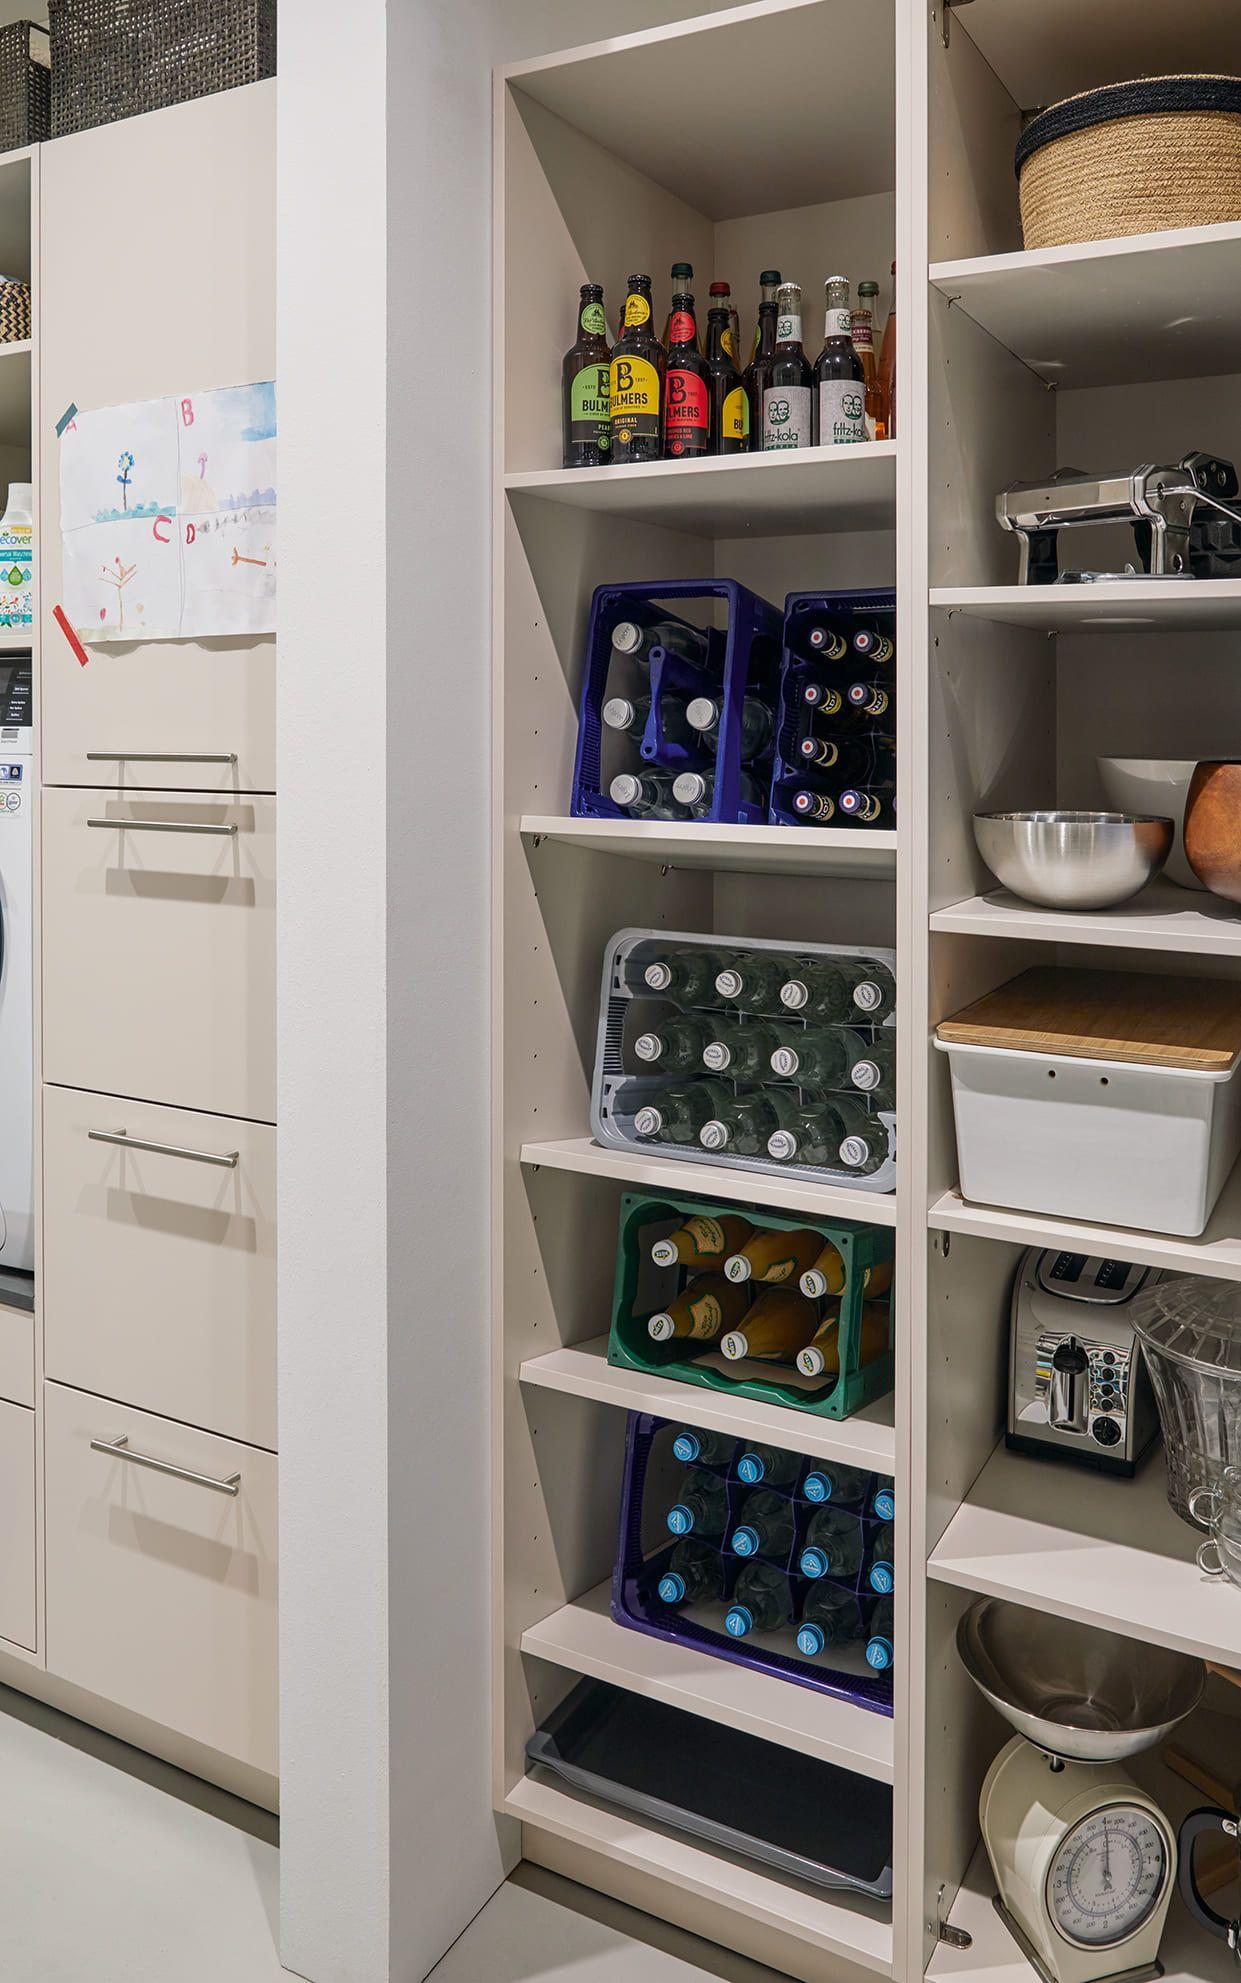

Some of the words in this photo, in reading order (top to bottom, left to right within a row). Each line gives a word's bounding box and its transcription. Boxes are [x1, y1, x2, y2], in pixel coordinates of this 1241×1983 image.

[582, 400, 610, 412] BULM
[181, 399, 194, 426] B
[666, 407, 700, 418] LMERS
[733, 419, 744, 431] BU
[153, 515, 171, 543] C
[186, 523, 195, 544] D
[0, 535, 32, 545] ecover
[1056, 1880, 1062, 1889] 3
[1102, 1921, 1109, 1929] 2
